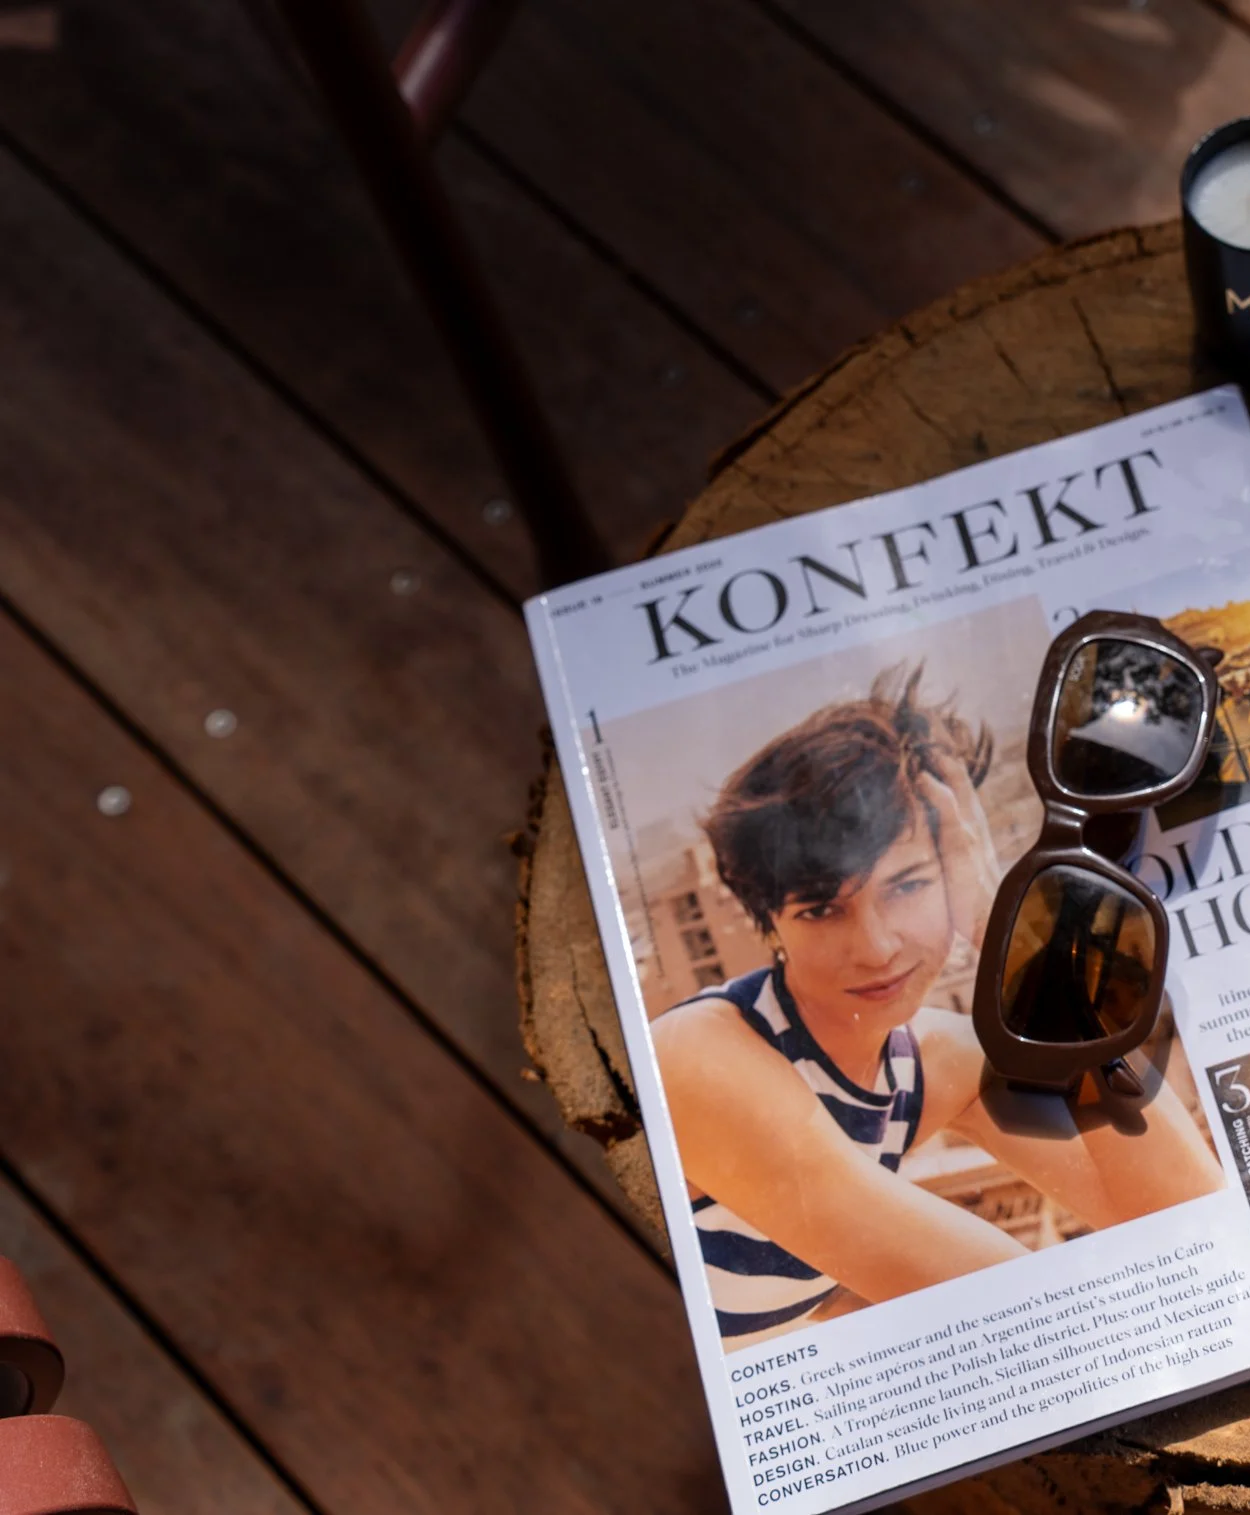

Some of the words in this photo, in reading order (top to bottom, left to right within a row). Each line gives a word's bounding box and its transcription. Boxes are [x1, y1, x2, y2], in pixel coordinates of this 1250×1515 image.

[635, 449, 1161, 665] KONFEKT
[639, 567, 691, 590] SUMMER
[668, 661, 700, 680] The
[699, 639, 772, 669] Magazine
[769, 631, 797, 649] for
[795, 619, 845, 641] Sharp
[842, 601, 914, 628] Dressing,
[911, 580, 982, 608] Drinking,
[1034, 544, 1084, 571] Travel
[587, 707, 603, 744] 1
[729, 1343, 819, 1384] CONTENTS
[734, 1378, 796, 1409] LOOKS.
[799, 1360, 846, 1386] Greek
[847, 1336, 922, 1371] swimwear
[924, 1323, 953, 1345] and
[954, 1318, 980, 1334] the
[981, 1295, 1043, 1325] season's
[1043, 1285, 1076, 1304] best
[1077, 1260, 1156, 1293] ensembles
[1156, 1254, 1173, 1268] in
[1173, 1240, 1214, 1261] Cairo
[738, 1391, 820, 1428] HOSTING.
[824, 1375, 873, 1399] Alpine
[875, 1356, 926, 1383] apéros
[927, 1343, 957, 1365] and
[957, 1339, 978, 1354] an
[980, 1314, 1053, 1347] Argentine
[1055, 1295, 1107, 1321] artist's
[1107, 1280, 1155, 1303] studio
[1155, 1264, 1199, 1288] lunch
[742, 1416, 810, 1448] TRAVEL.
[812, 1397, 868, 1424] Sailing
[867, 1374, 923, 1406] around
[923, 1369, 950, 1386] the
[950, 1351, 998, 1377] Polish
[998, 1341, 1030, 1360] lake
[1032, 1322, 1091, 1349] district.
[1091, 1309, 1129, 1329] Plus:
[1130, 1300, 1156, 1317] our
[1157, 1283, 1204, 1308] hotels
[1205, 1269, 1246, 1295] guide
[747, 1430, 826, 1468] FASHION.
[829, 1423, 844, 1440] A
[843, 1394, 937, 1433] Tropézienne
[937, 1374, 994, 1402] launch,
[994, 1356, 1051, 1383] Sicilian
[1051, 1329, 1132, 1364] silhouettes
[1133, 1315, 1162, 1337] and
[1162, 1298, 1225, 1327] Mexican
[752, 1453, 821, 1488] DESIGN.
[824, 1433, 884, 1461] Catalan
[885, 1412, 941, 1441] seaside
[941, 1398, 987, 1422] living
[987, 1384, 1017, 1406] and
[1018, 1384, 1029, 1396] a
[1029, 1365, 1082, 1392] master
[1083, 1355, 1099, 1373] of
[1100, 1332, 1185, 1367] Indonesian
[1186, 1316, 1233, 1340] rattan
[756, 1450, 890, 1507] CONVERSATION.
[893, 1439, 929, 1459] Blue
[931, 1421, 978, 1450] power
[979, 1407, 1009, 1430] and
[1010, 1402, 1036, 1419] the
[1038, 1374, 1119, 1413] geopolitics
[1120, 1364, 1136, 1381] of
[1138, 1360, 1163, 1376] the
[1164, 1346, 1200, 1367] high
[1201, 1337, 1234, 1356] seas
